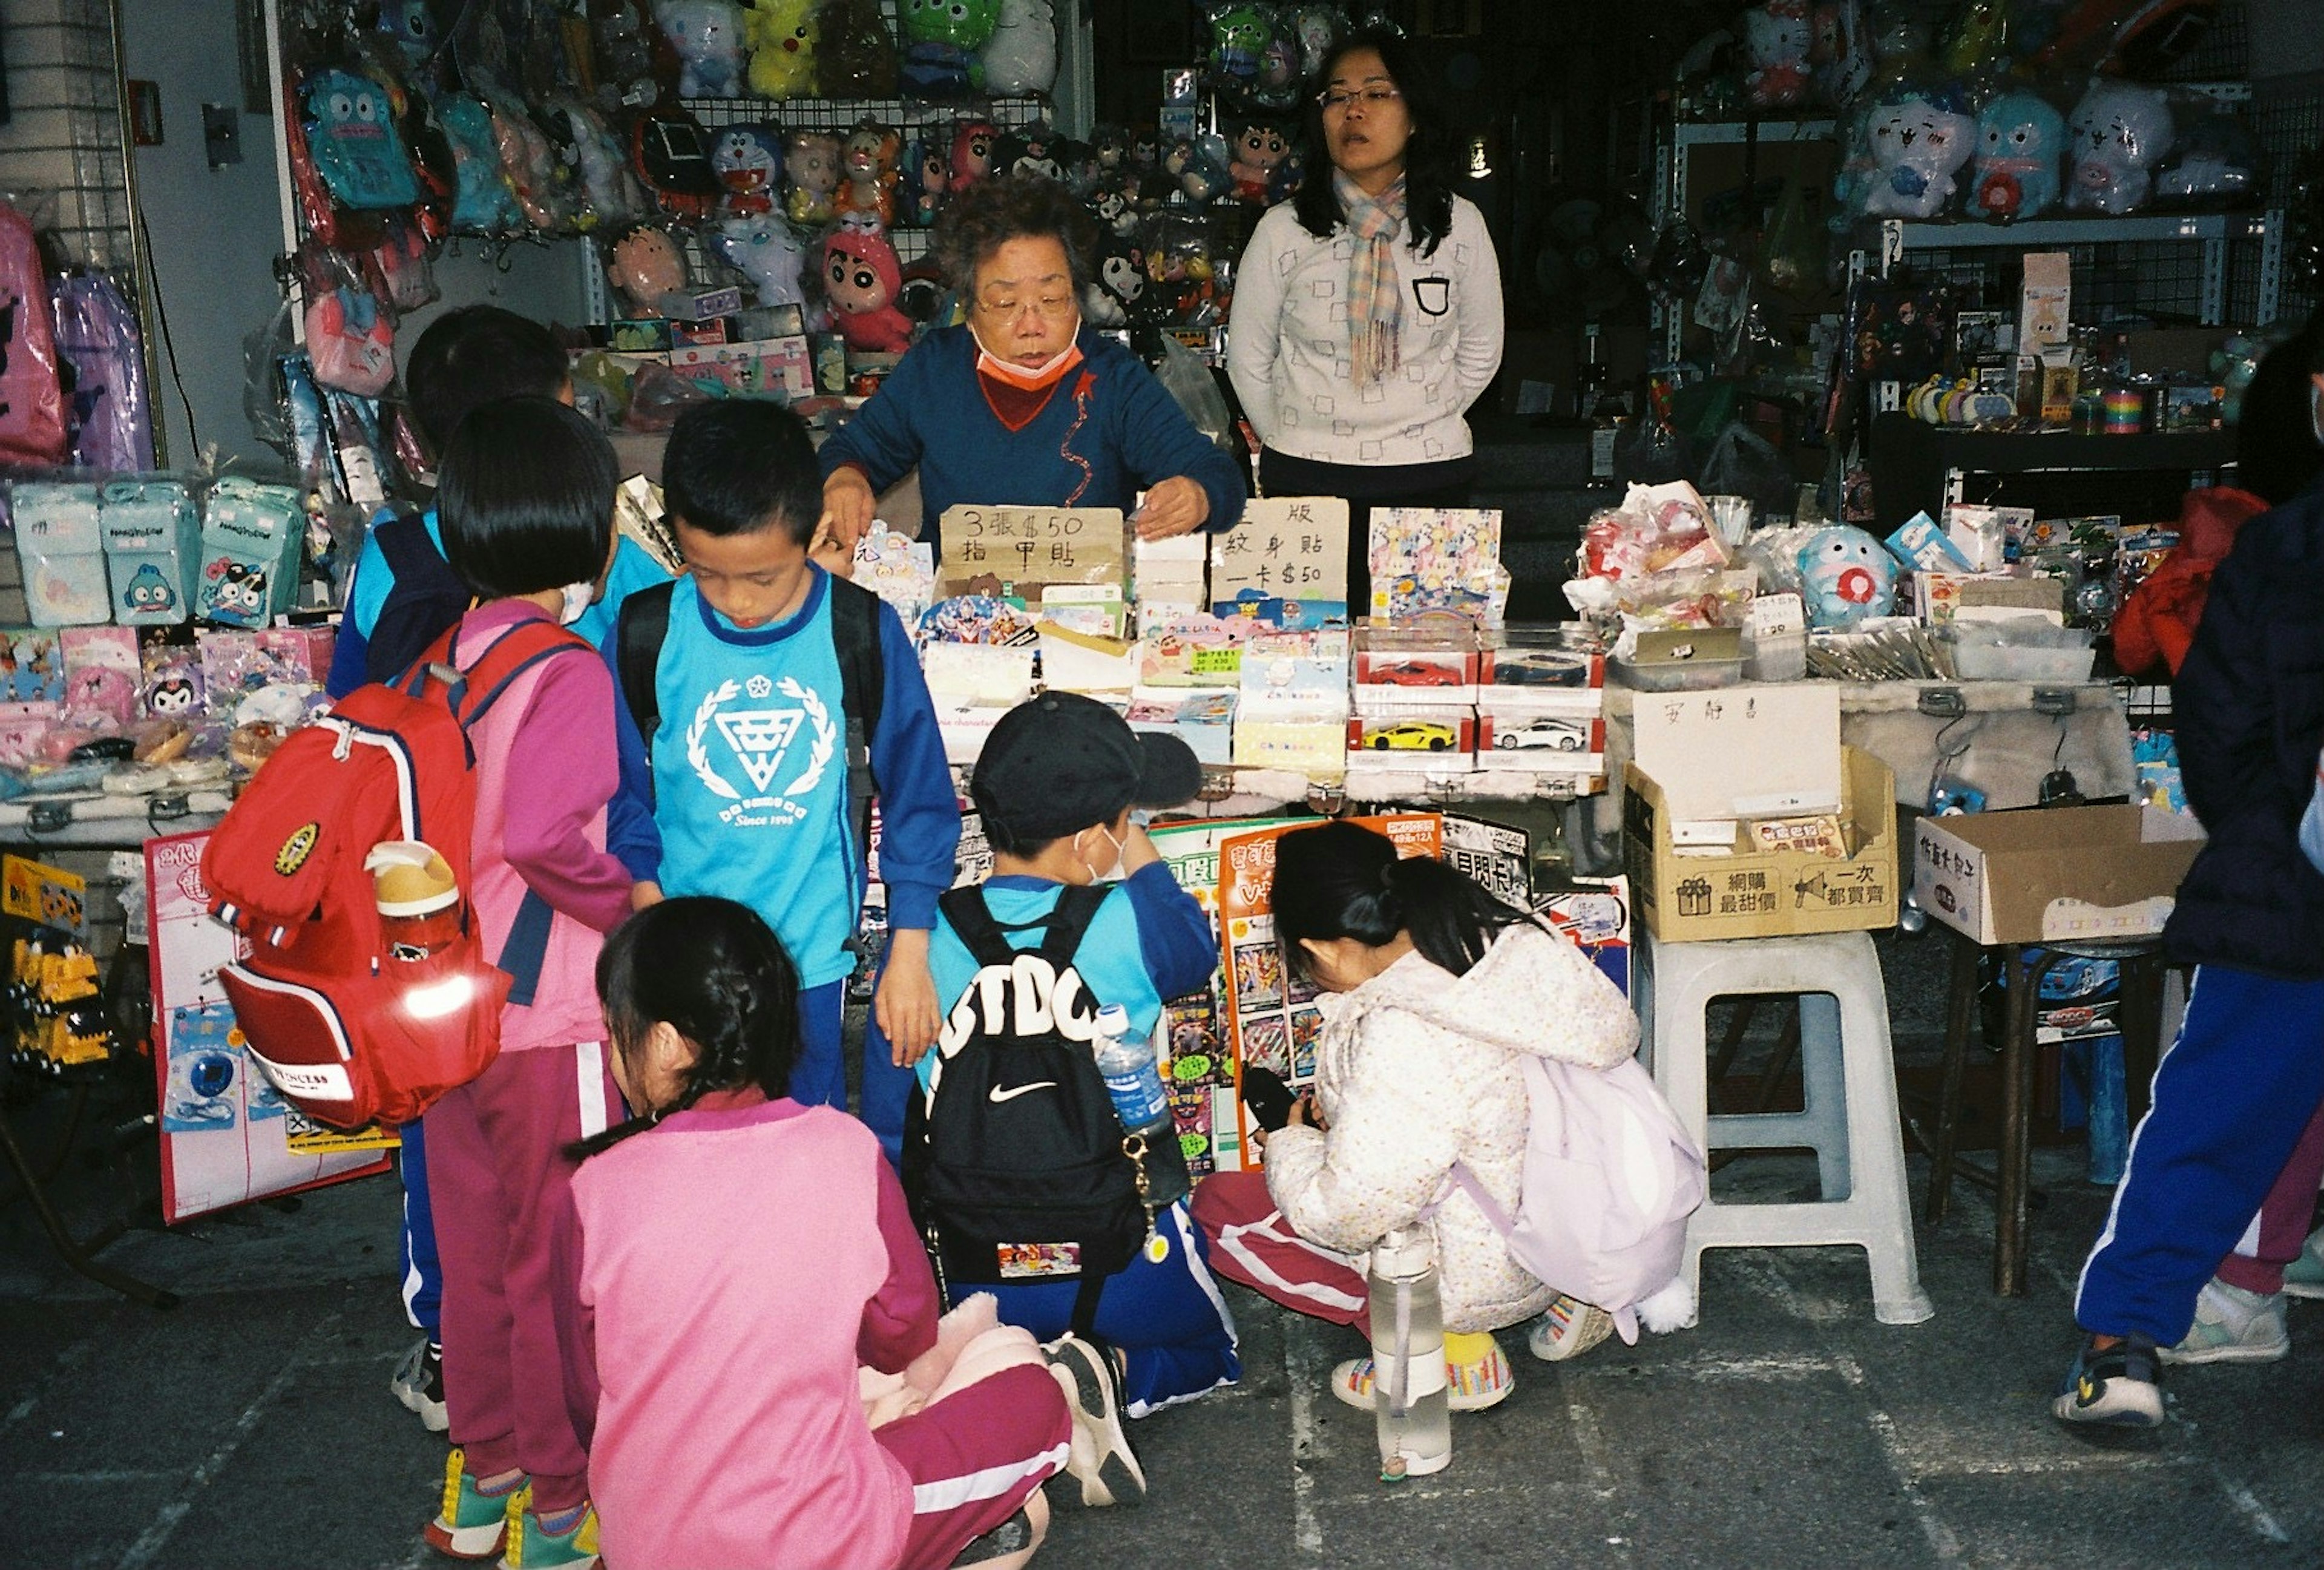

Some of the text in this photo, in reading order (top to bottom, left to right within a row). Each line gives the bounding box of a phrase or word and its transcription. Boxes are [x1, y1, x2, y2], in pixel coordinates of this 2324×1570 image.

[1728, 872, 1765, 892] 網購
[1837, 865, 1874, 882] 一次
[1720, 892, 1776, 913] 最甜價
[1828, 885, 1883, 906] 都買齊
